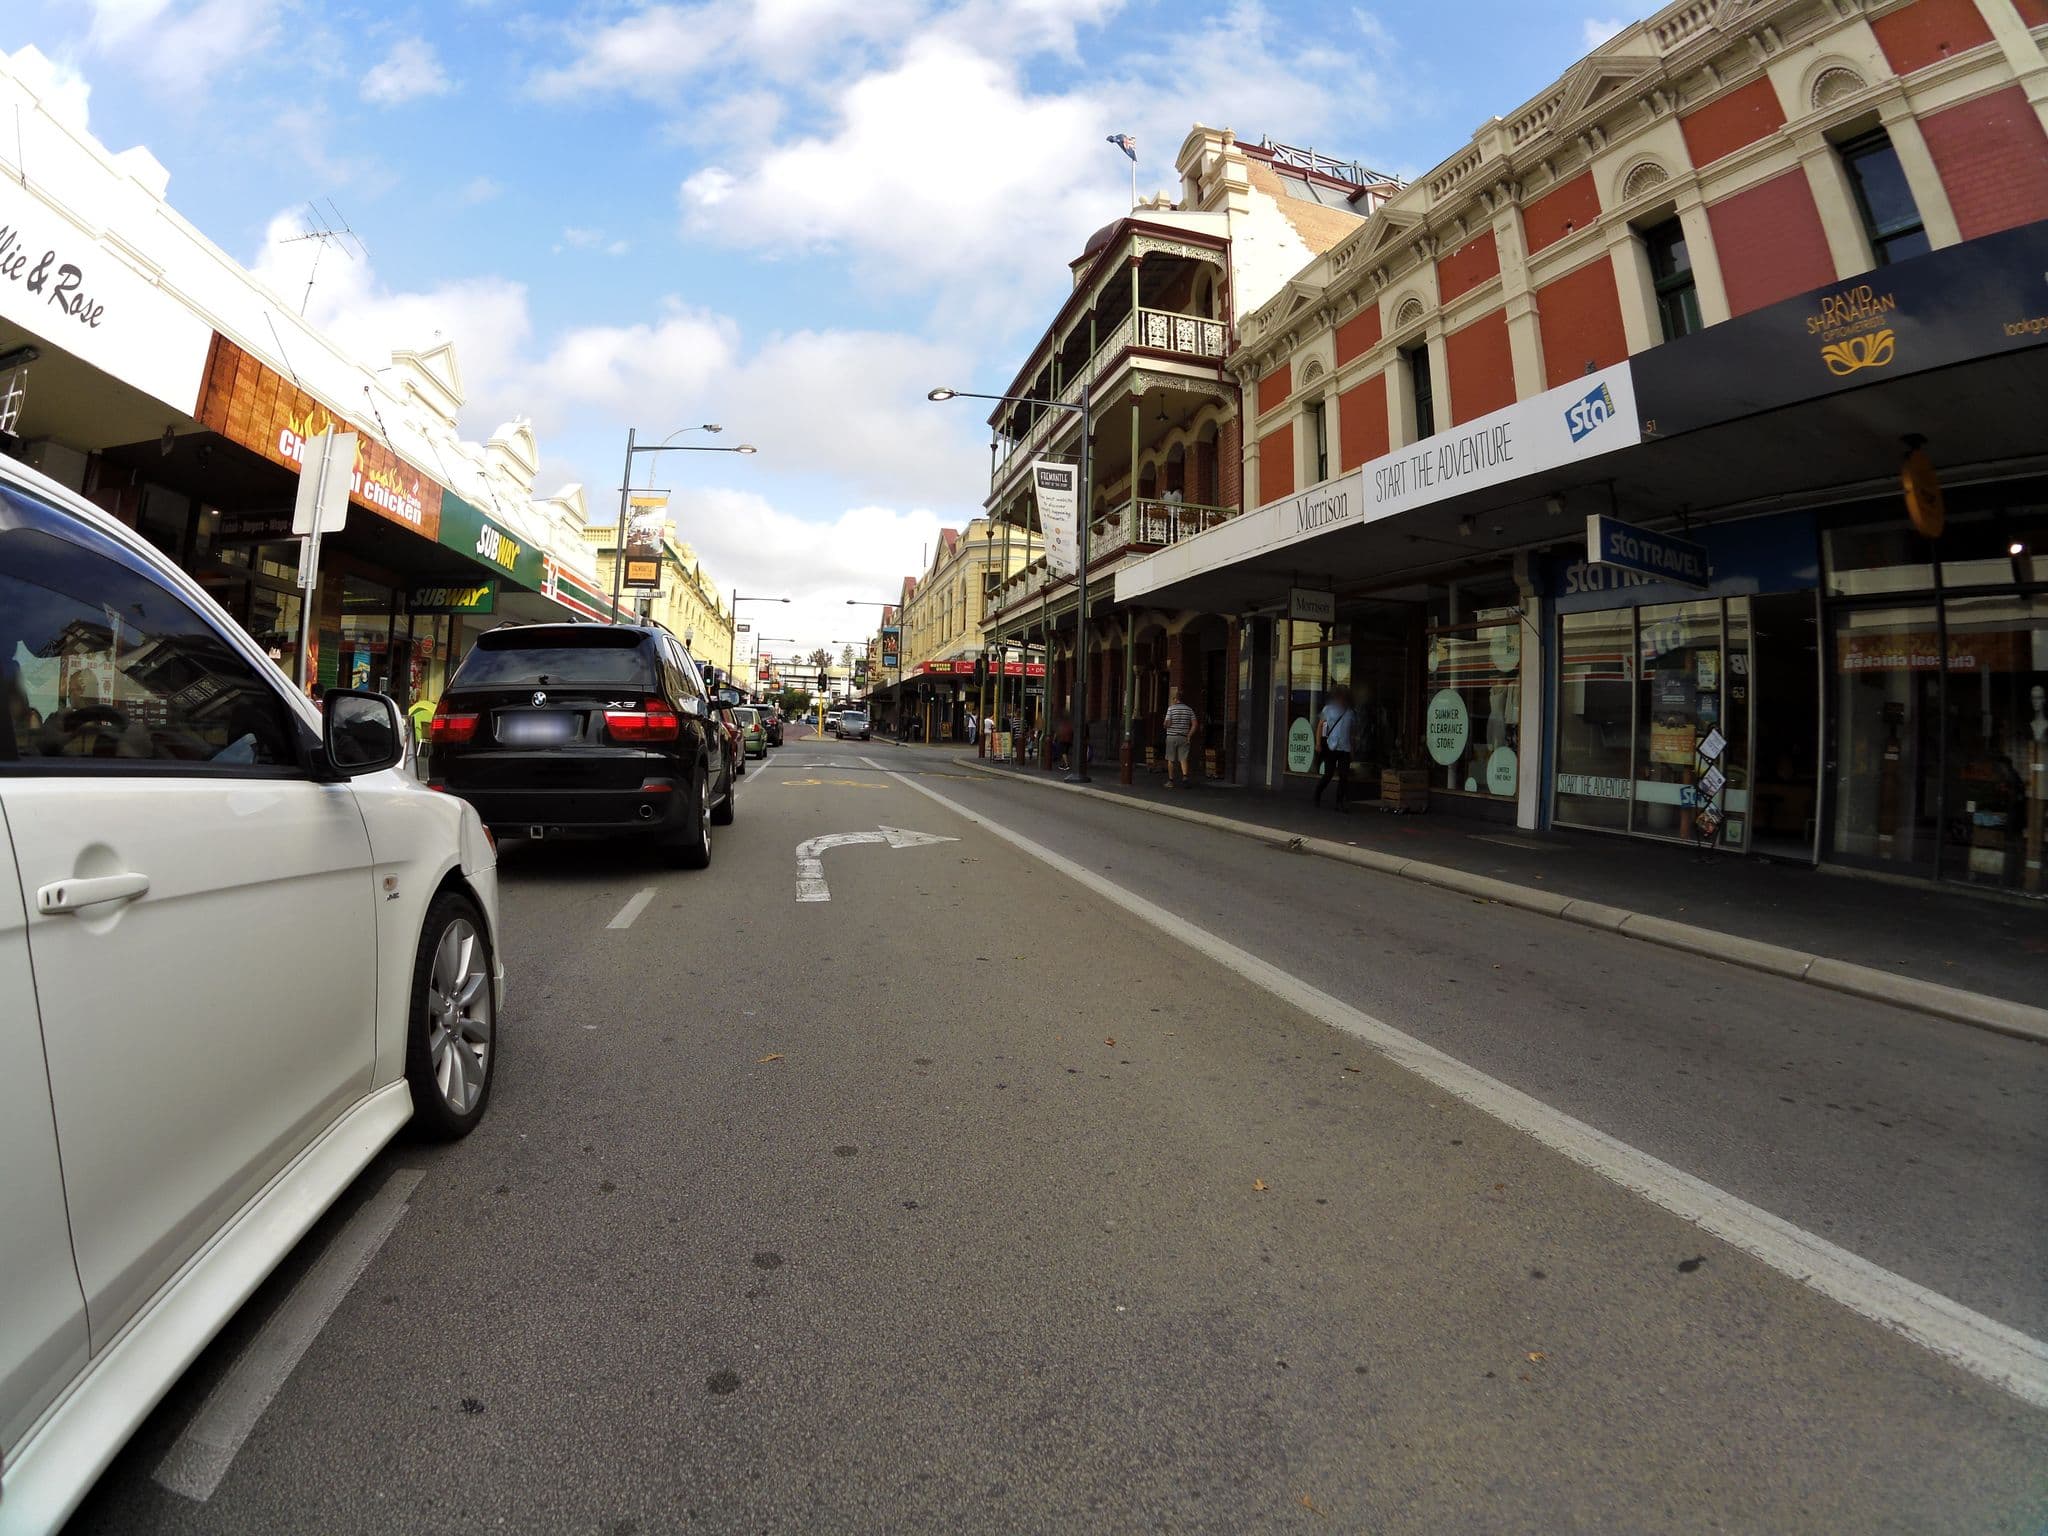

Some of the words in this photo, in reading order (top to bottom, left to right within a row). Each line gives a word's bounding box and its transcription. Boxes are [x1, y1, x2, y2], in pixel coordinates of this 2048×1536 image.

[27, 250, 55, 295] &
[48, 263, 104, 328] Rose
[1822, 285, 1873, 314] DAVID
[1807, 293, 1896, 334] SHANAHAN
[1570, 399, 1608, 434] sta
[1646, 420, 1657, 433] 51
[1375, 461, 1407, 503] START
[1410, 450, 1434, 491] THE
[1437, 422, 1514, 483] ADVENTURE
[364, 480, 422, 525] chicken
[1295, 490, 1349, 533] Morrison
[476, 524, 521, 572] SUBWAY
[1610, 530, 1639, 560] sta
[1639, 540, 1704, 577] TRAVEL
[410, 586, 490, 607] SUBWAY
[1732, 686, 1745, 699] 53
[1435, 708, 1459, 720] SUMMER
[1293, 733, 1308, 742] SUMMER
[1430, 723, 1463, 735] CLEARANCE
[1436, 738, 1455, 749] STORE
[1560, 775, 1578, 792] START
[1580, 777, 1592, 794] THE
[1593, 777, 1631, 798] ADVENTURE
